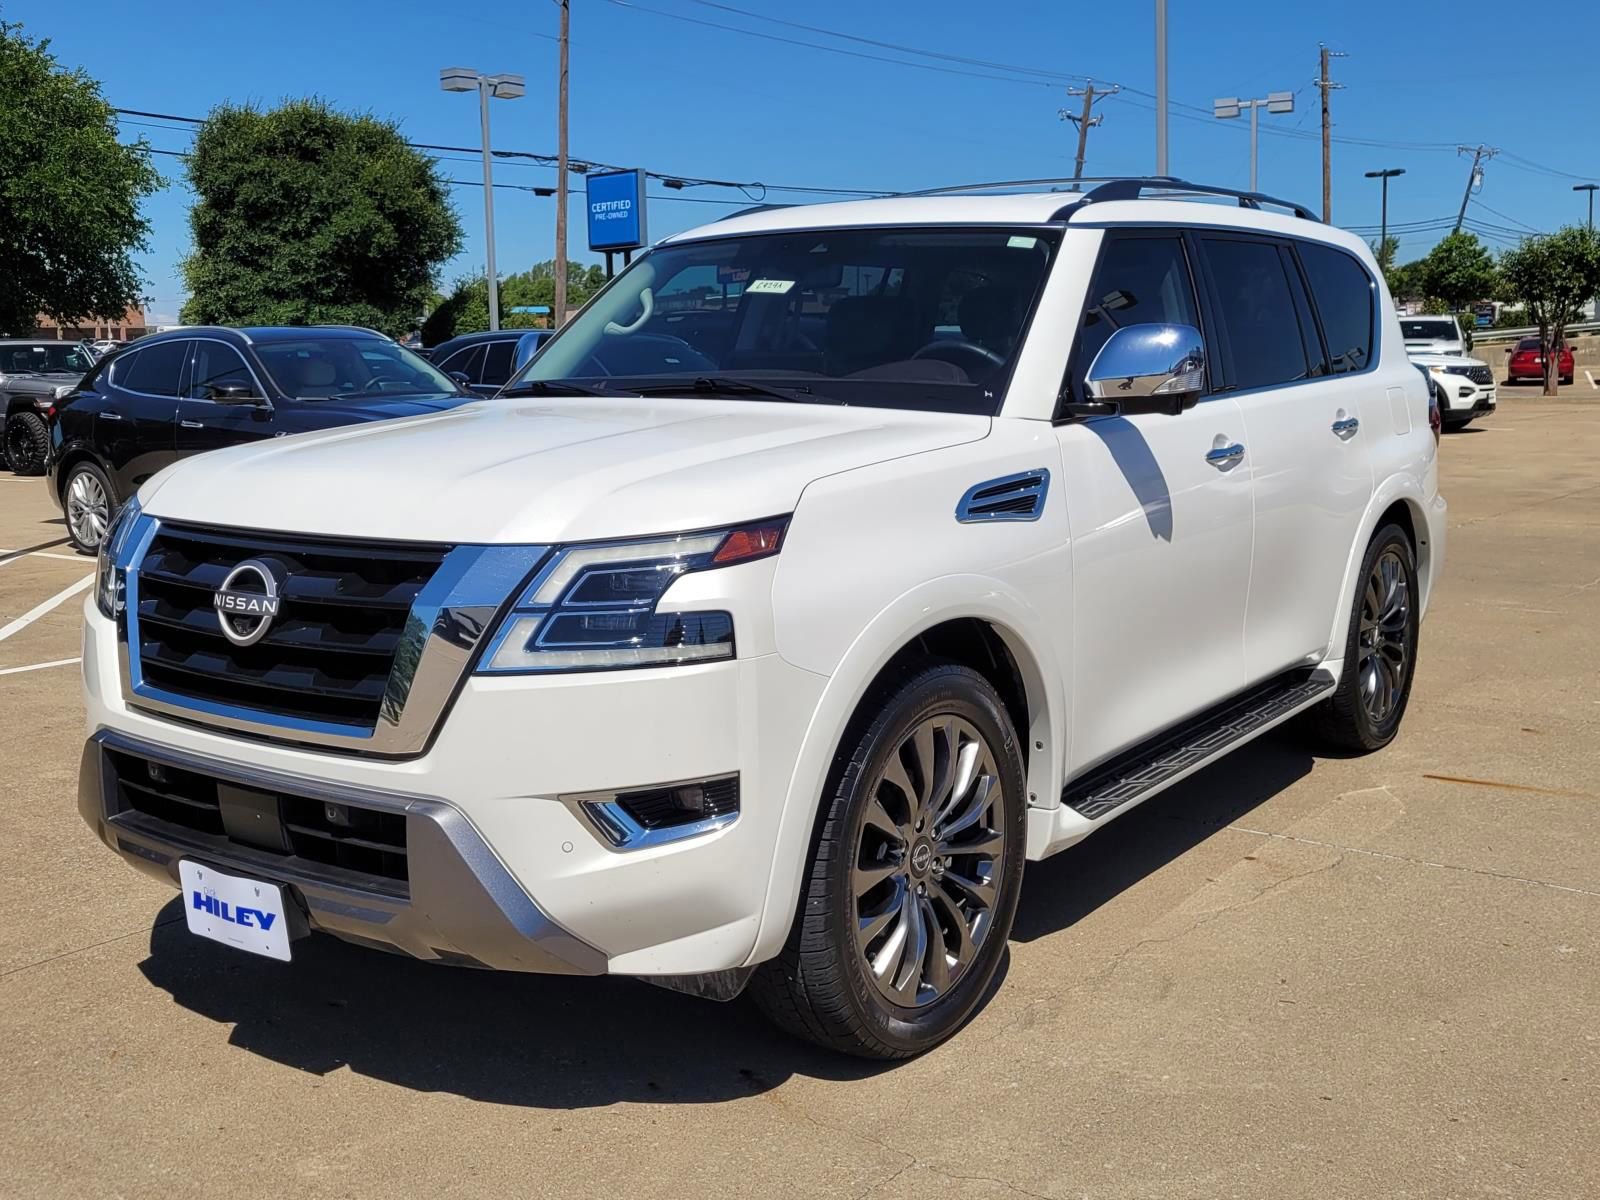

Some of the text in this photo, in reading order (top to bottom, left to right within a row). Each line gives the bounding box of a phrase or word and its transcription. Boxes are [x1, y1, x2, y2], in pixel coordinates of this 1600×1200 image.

[591, 200, 631, 213] CERTIFIED
[595, 211, 628, 221] PRE-OWNED
[213, 593, 277, 613] NISSAN
[193, 890, 276, 931] HILEY
